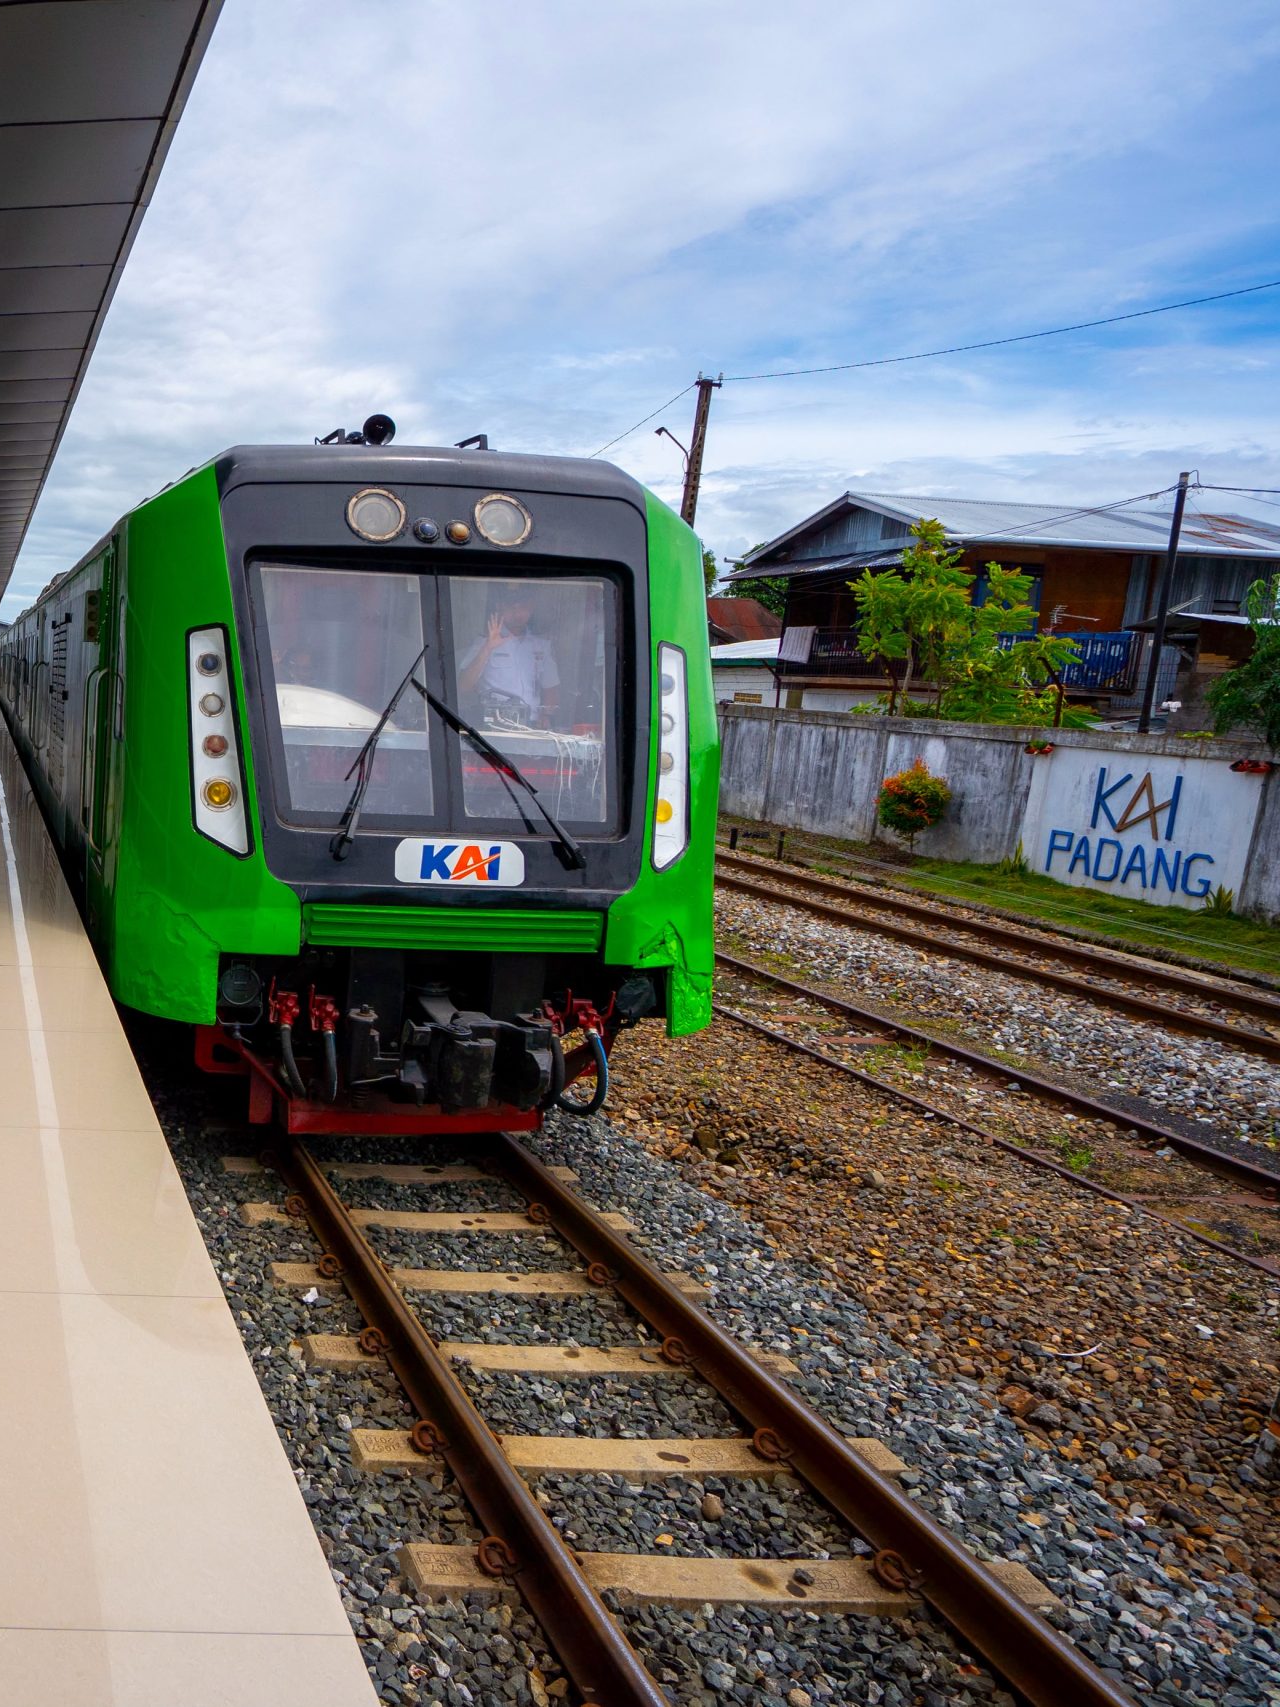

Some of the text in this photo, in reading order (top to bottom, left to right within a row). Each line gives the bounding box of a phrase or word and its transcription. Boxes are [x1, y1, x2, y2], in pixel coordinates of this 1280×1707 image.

[1090, 767, 1183, 841] KAI
[420, 844, 501, 881] KAI
[1045, 829, 1215, 898] PADANG
